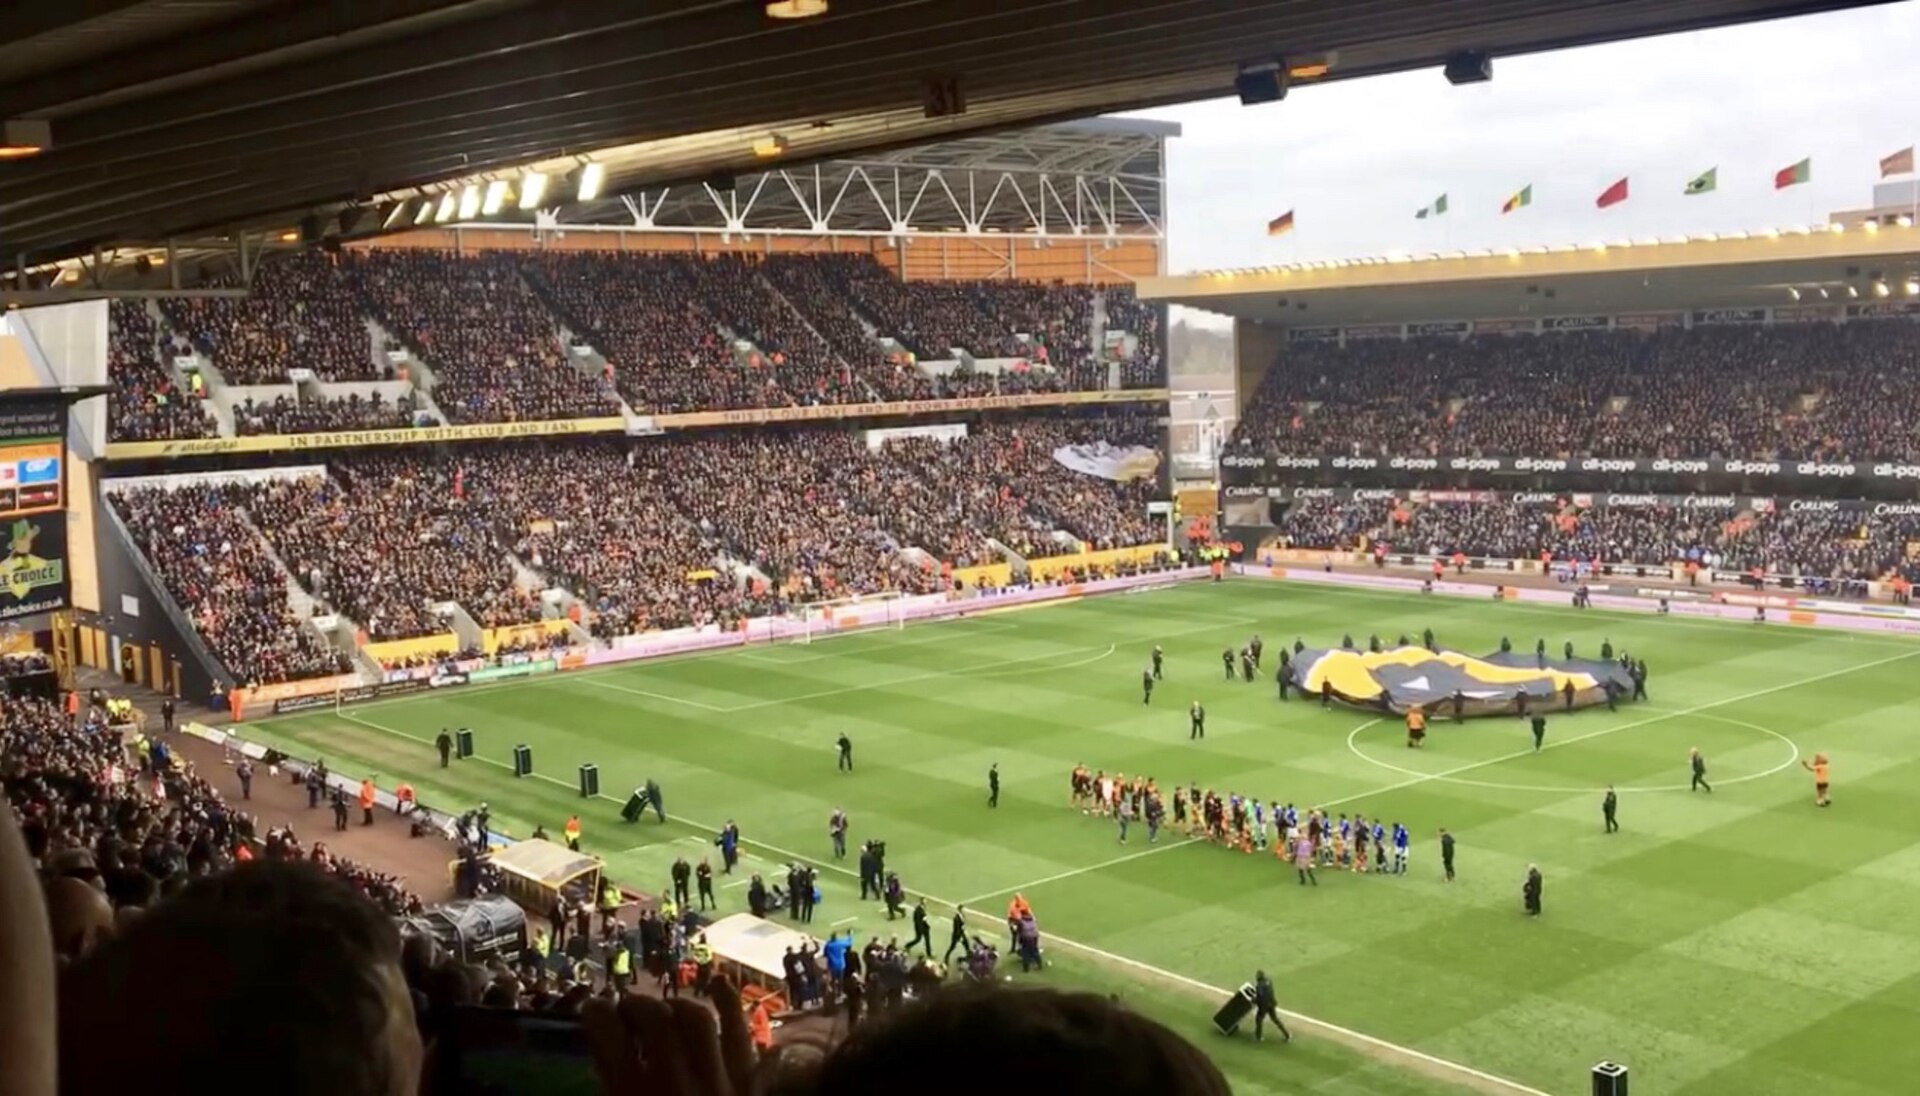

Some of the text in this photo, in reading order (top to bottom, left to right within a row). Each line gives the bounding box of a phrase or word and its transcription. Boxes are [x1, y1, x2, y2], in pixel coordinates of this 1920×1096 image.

[290, 421, 577, 447] IN PARTNERSHIP WITH CLUB AND FANS
[1222, 456, 1265, 467] all-paye
[1277, 456, 1320, 468] all-paye
[1332, 457, 1377, 469] all-paye
[1390, 456, 1438, 470] all-paye
[1451, 457, 1500, 471] all-paye
[1515, 457, 1567, 472] all-paye
[1582, 458, 1636, 473] all-paye
[1652, 459, 1708, 474] all-paye
[1725, 460, 1781, 476] all-paye
[1797, 461, 1856, 477] all-paye
[1225, 486, 1264, 497] CARLING
[1294, 487, 1335, 499] CARLING
[1354, 488, 1395, 501] CARLING
[1513, 492, 1557, 503] CARLING
[1608, 494, 1658, 506] CARLING
[1684, 495, 1735, 508] CARLING
[1790, 499, 1839, 512] CARLING
[1874, 502, 1920, 516] CARLIN
[13, 566, 55, 584] CHOICE
